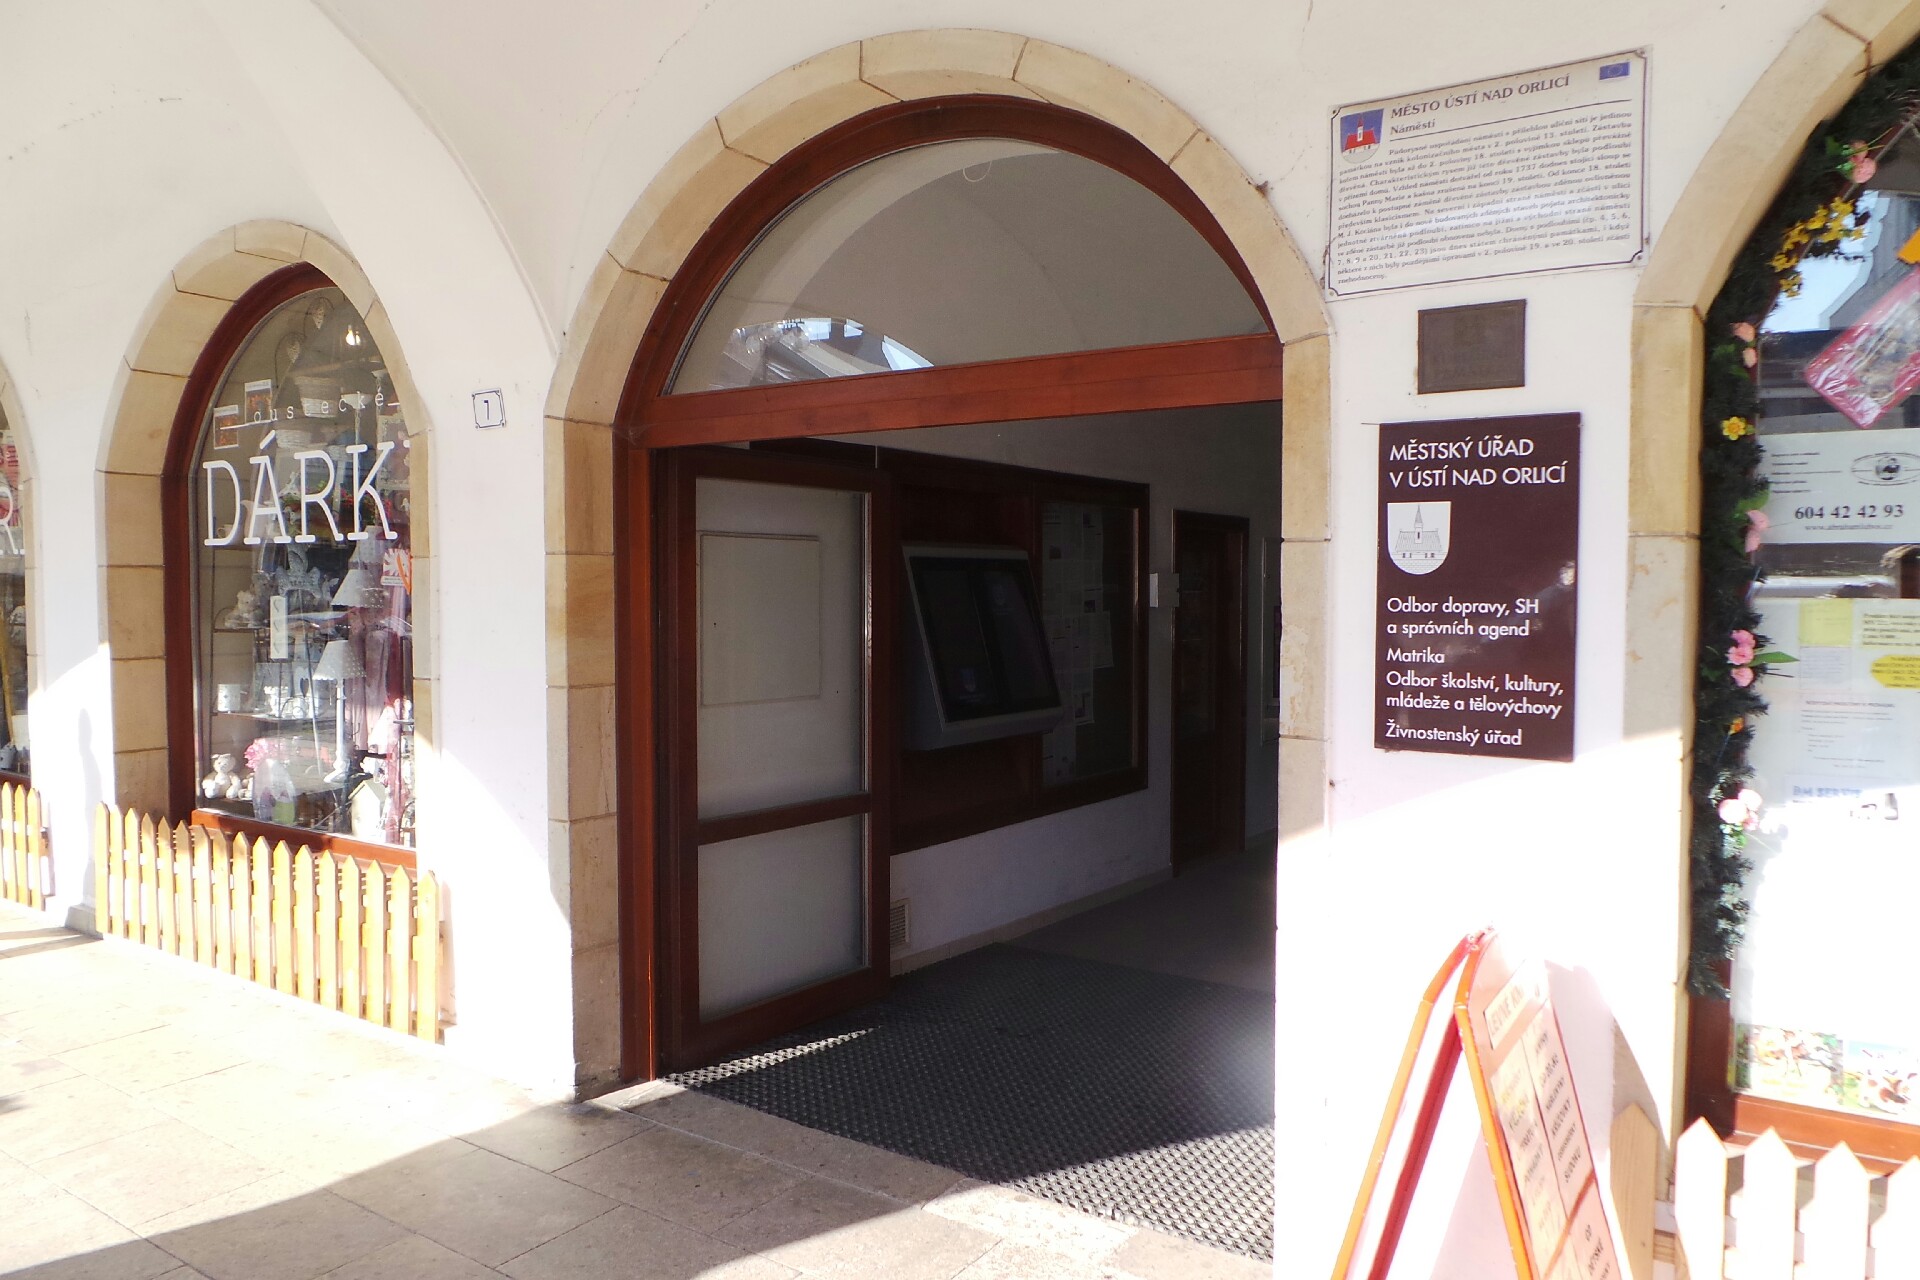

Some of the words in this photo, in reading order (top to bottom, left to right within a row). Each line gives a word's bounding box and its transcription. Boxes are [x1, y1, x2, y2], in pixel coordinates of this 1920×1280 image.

[1390, 99, 1439, 119] MĚSTO
[1445, 89, 1476, 108] ÚSTÍ
[1482, 86, 1513, 102] NAD
[1518, 74, 1569, 95] ORLICÍ
[1389, 118, 1435, 134] Náměstí
[1390, 437, 1472, 461] MĚSTSKÝ
[1478, 436, 1534, 458] ÚŘAD
[1390, 472, 1402, 488] V
[1408, 466, 1447, 488] ÚSTÍ
[1452, 468, 1496, 486] NAD
[1502, 461, 1568, 485] ORLICÍ
[203, 430, 409, 546] DÁRK
[1795, 506, 1825, 519] 604
[1830, 505, 1851, 519] 42
[1857, 505, 1877, 518] 42
[1883, 504, 1904, 517] 93
[1387, 598, 1438, 613] Odbor
[1443, 599, 1511, 617] dopravy,
[1515, 599, 1538, 614] SH
[1387, 623, 1397, 634] a
[1402, 620, 1473, 638] správních
[1479, 620, 1529, 640] agend
[1387, 648, 1445, 663] Matrika
[1386, 671, 1438, 687] Odbor
[1442, 674, 1499, 692] školství,
[1504, 674, 1564, 696] kultury,
[1386, 694, 1450, 709] mládeže
[1455, 699, 1464, 710] a
[1469, 696, 1561, 719] tělovýchovy
[1386, 722, 1480, 746] Živnostenský
[1484, 728, 1521, 745] úřad
